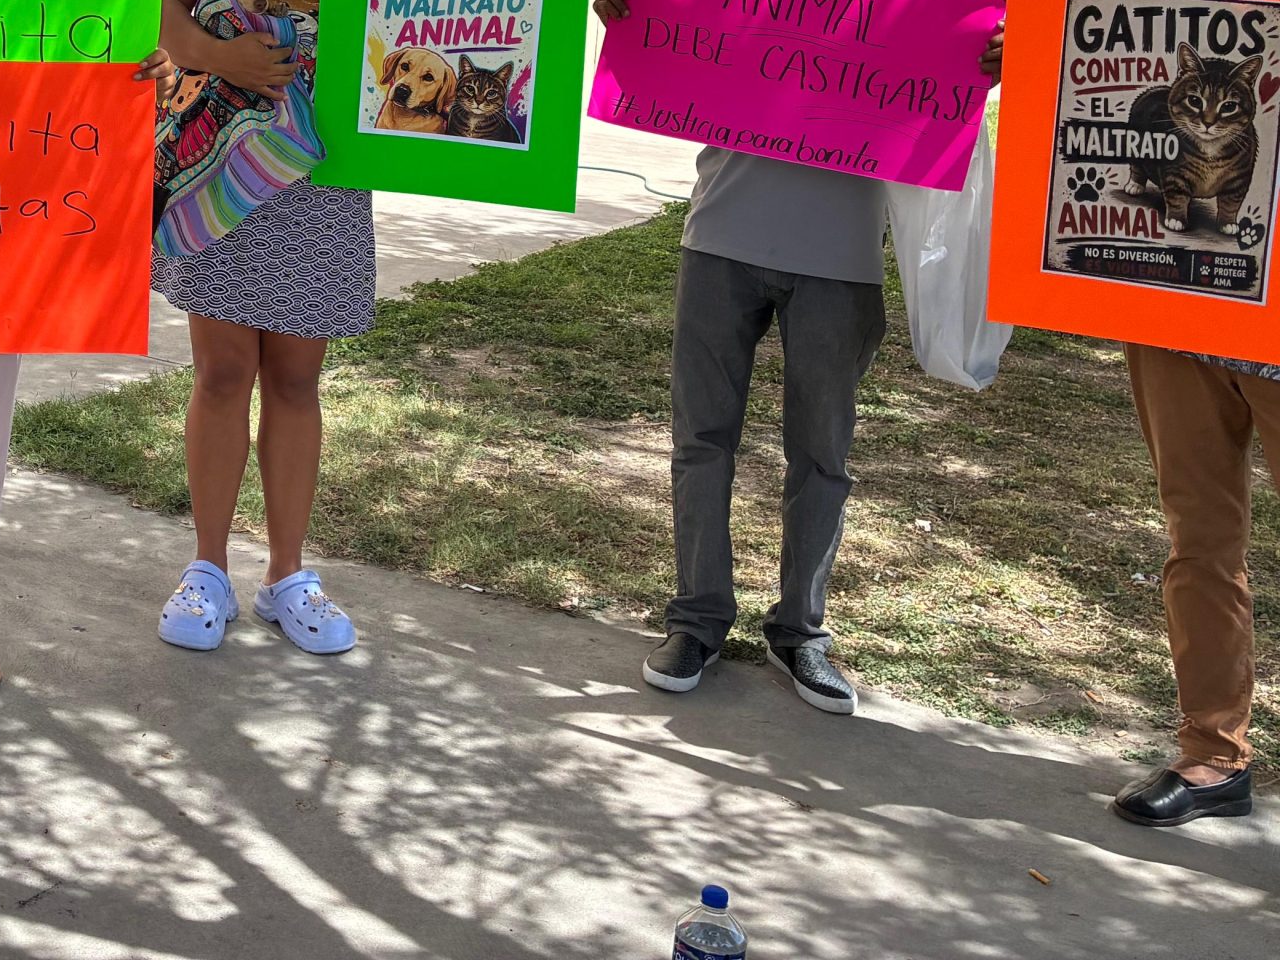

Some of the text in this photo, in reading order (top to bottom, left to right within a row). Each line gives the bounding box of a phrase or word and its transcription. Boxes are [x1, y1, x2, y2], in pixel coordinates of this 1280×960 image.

[394, 15, 523, 48] ANIMAL
[1074, 3, 1266, 57] GATITOS
[643, 17, 991, 126] DEBE CASTIGARSE
[1070, 57, 1169, 85] CONTRA
[1090, 97, 1114, 118] EL
[1066, 125, 1179, 161] MALTRATO
[1058, 202, 1166, 240] ANIMAL
[1084, 247, 1177, 266] NO ES DIVERSIÓN,
[1214, 256, 1247, 268] RESPETA
[1213, 267, 1247, 278] PROTEGE
[1213, 277, 1232, 287] AMA
